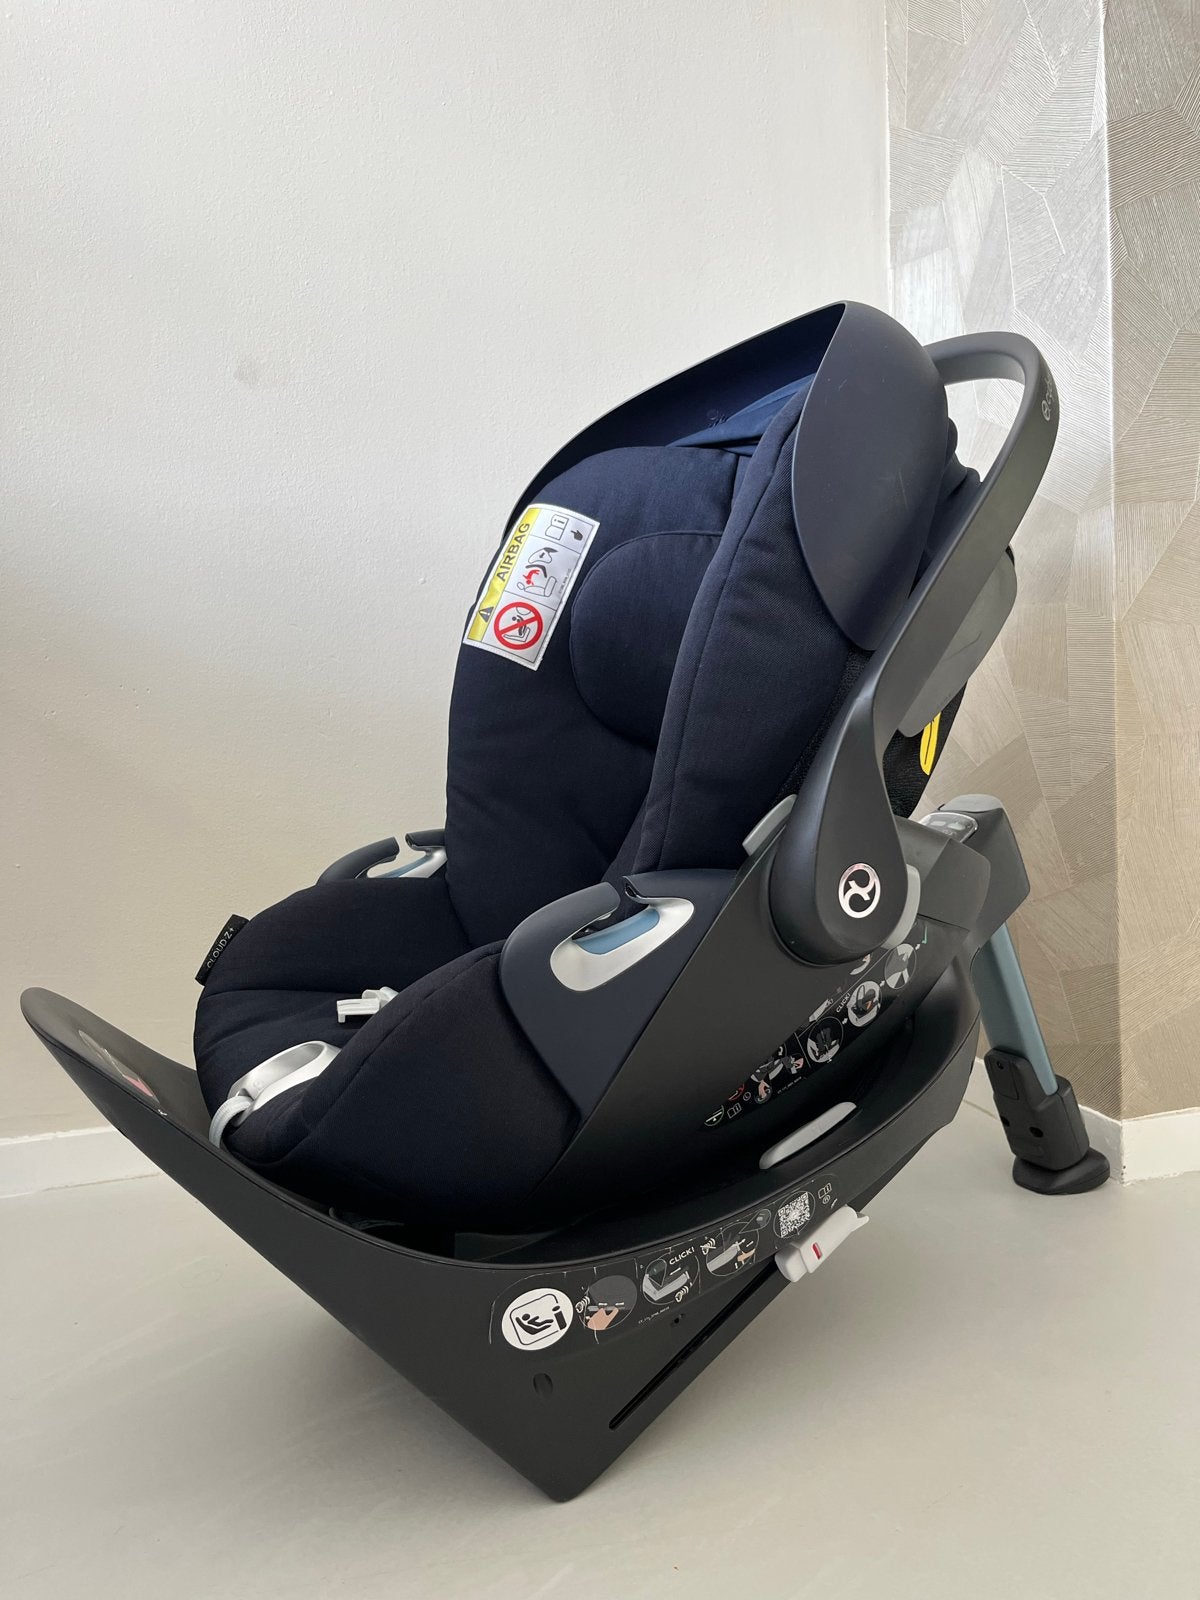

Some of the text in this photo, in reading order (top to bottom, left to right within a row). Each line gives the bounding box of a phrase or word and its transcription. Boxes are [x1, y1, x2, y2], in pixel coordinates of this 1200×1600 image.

[496, 522, 531, 582] AIRBAG
[206, 938, 228, 969] CLOUD
[835, 992, 851, 1013] CLICK!
[668, 1246, 695, 1265] CLICK!
